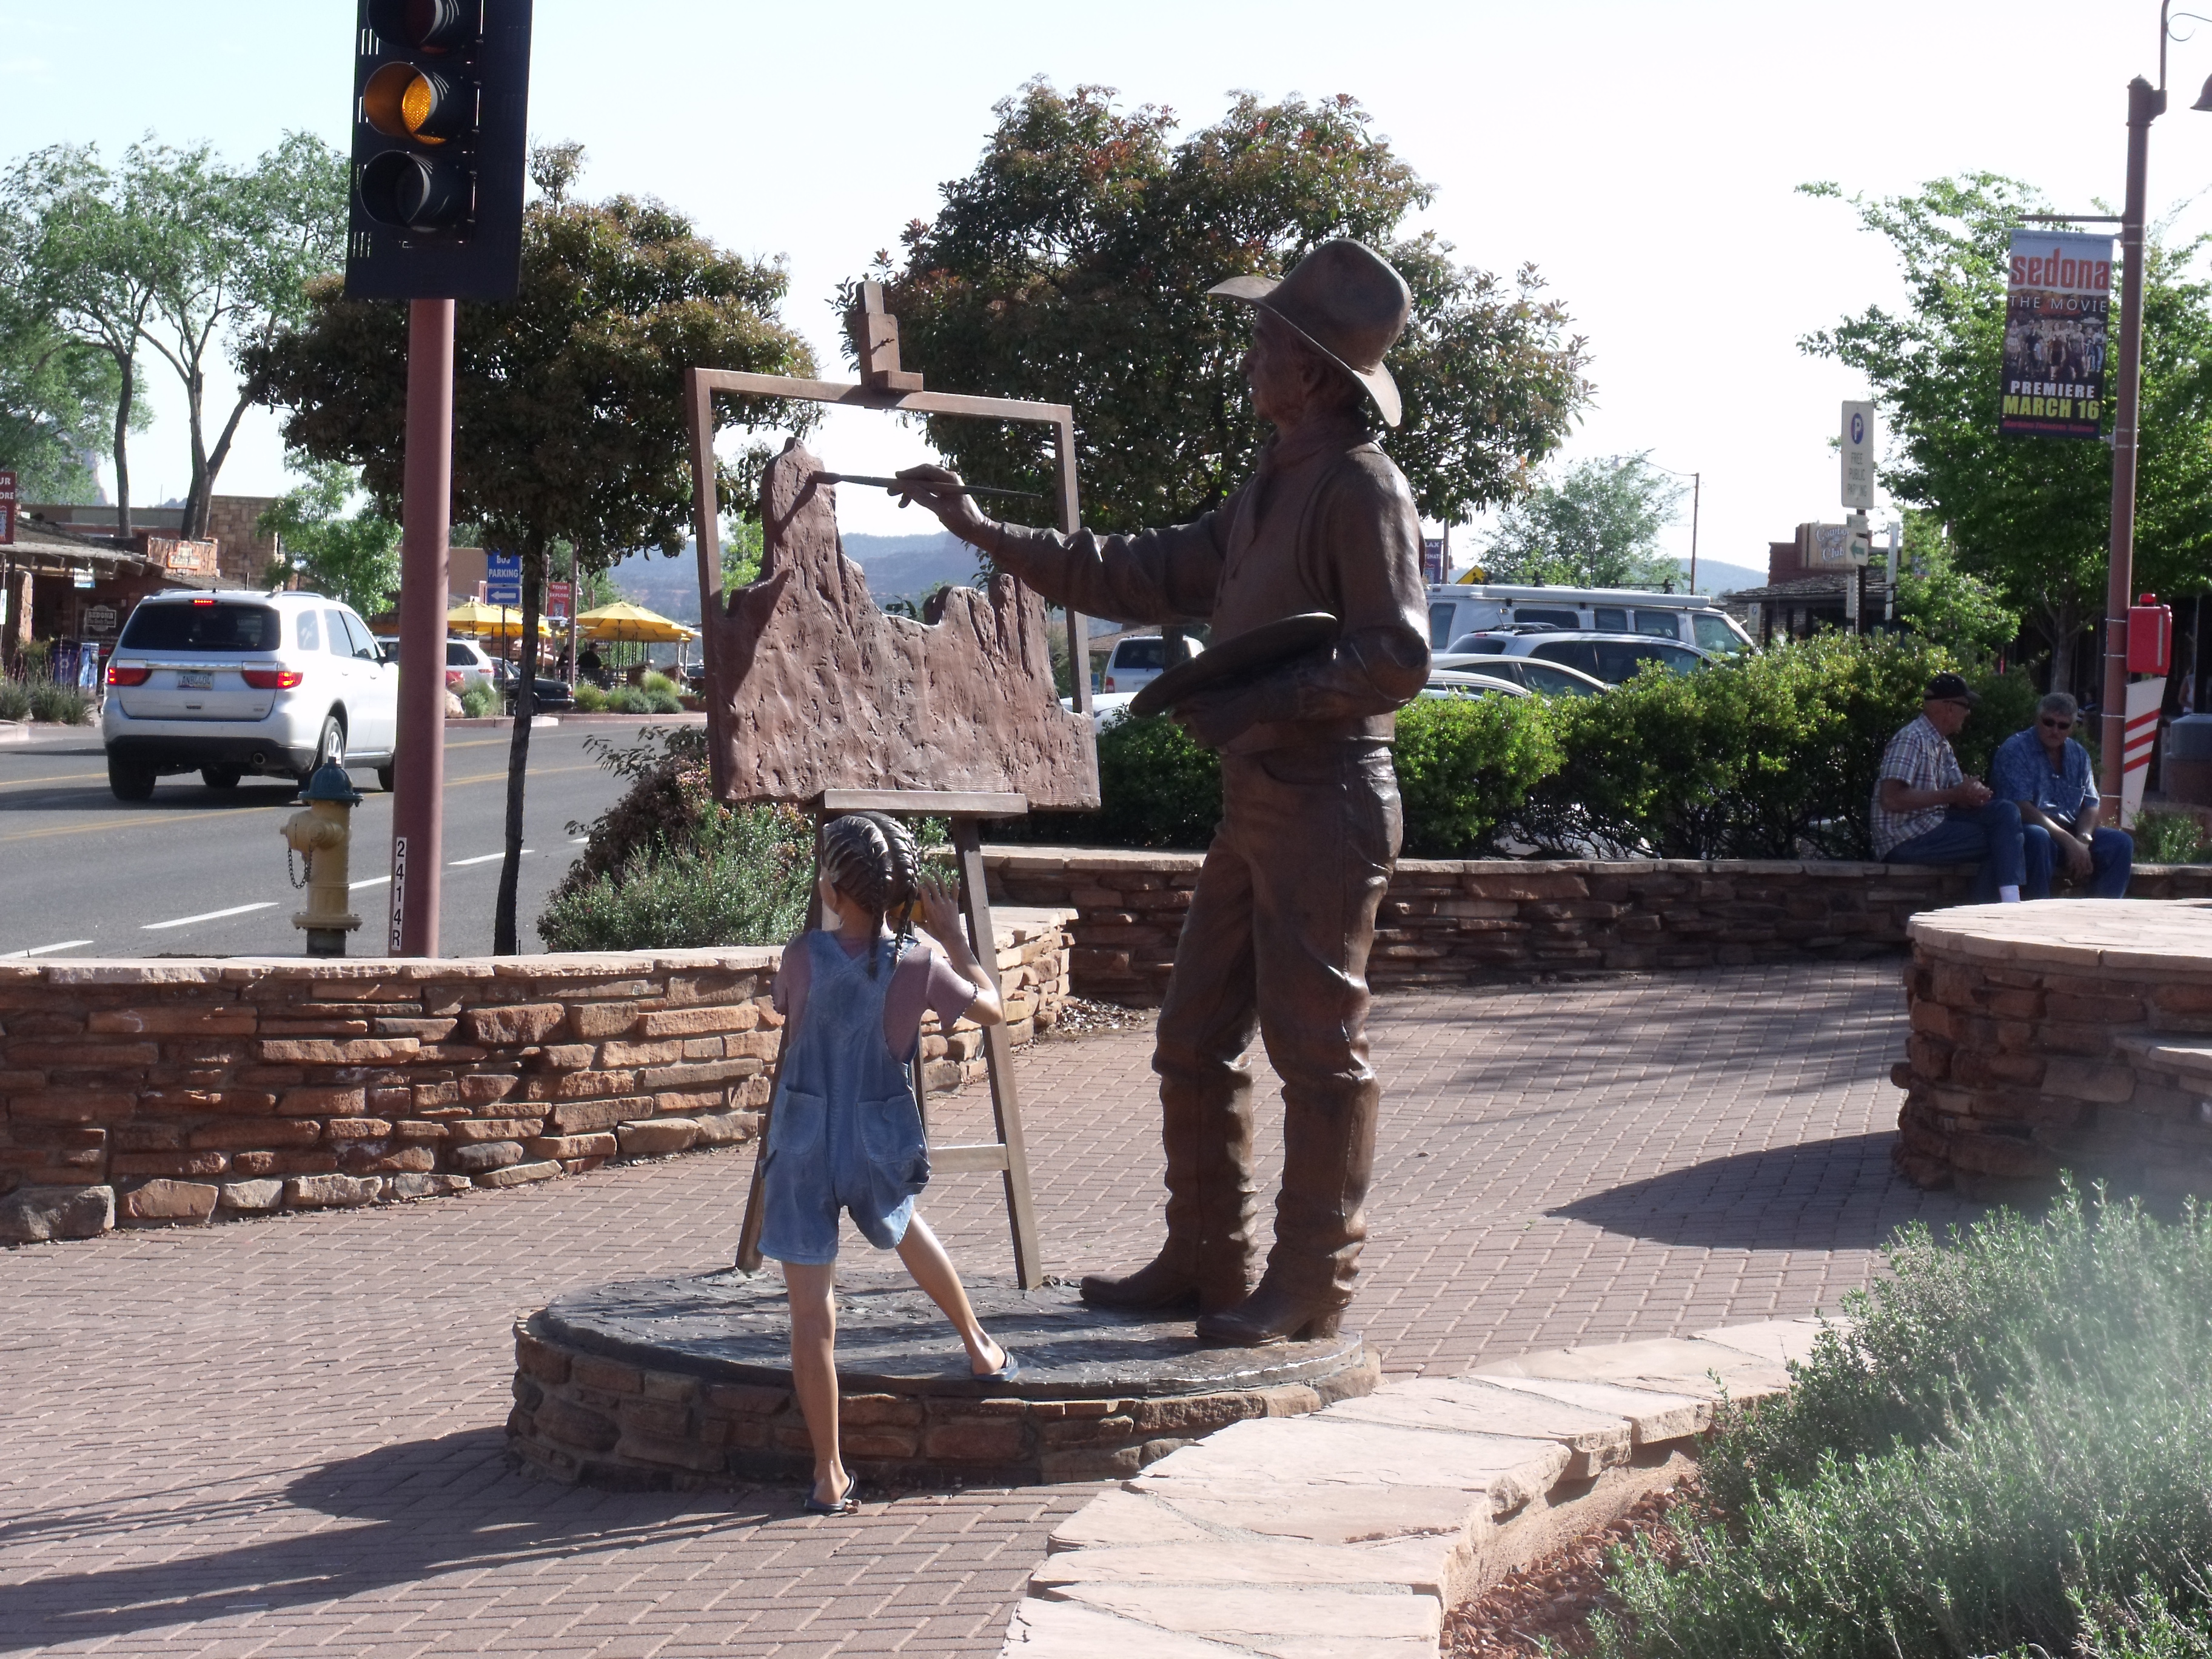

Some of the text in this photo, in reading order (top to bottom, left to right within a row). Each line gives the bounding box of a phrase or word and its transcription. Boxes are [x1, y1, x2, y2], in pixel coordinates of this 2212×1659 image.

[2011, 247, 2110, 290] sedona
[2009, 296, 2106, 312] THE MOVIE
[2010, 380, 2094, 399] PREMIERE
[2003, 395, 2100, 420] MARCH 16
[1851, 452, 1863, 464] FREE
[1849, 468, 1865, 481] PUBLIC
[1848, 483, 1867, 497] PARING
[1822, 546, 1845, 561] Club
[489, 569, 519, 578] PARKING
[88, 611, 114, 619] SEDONA
